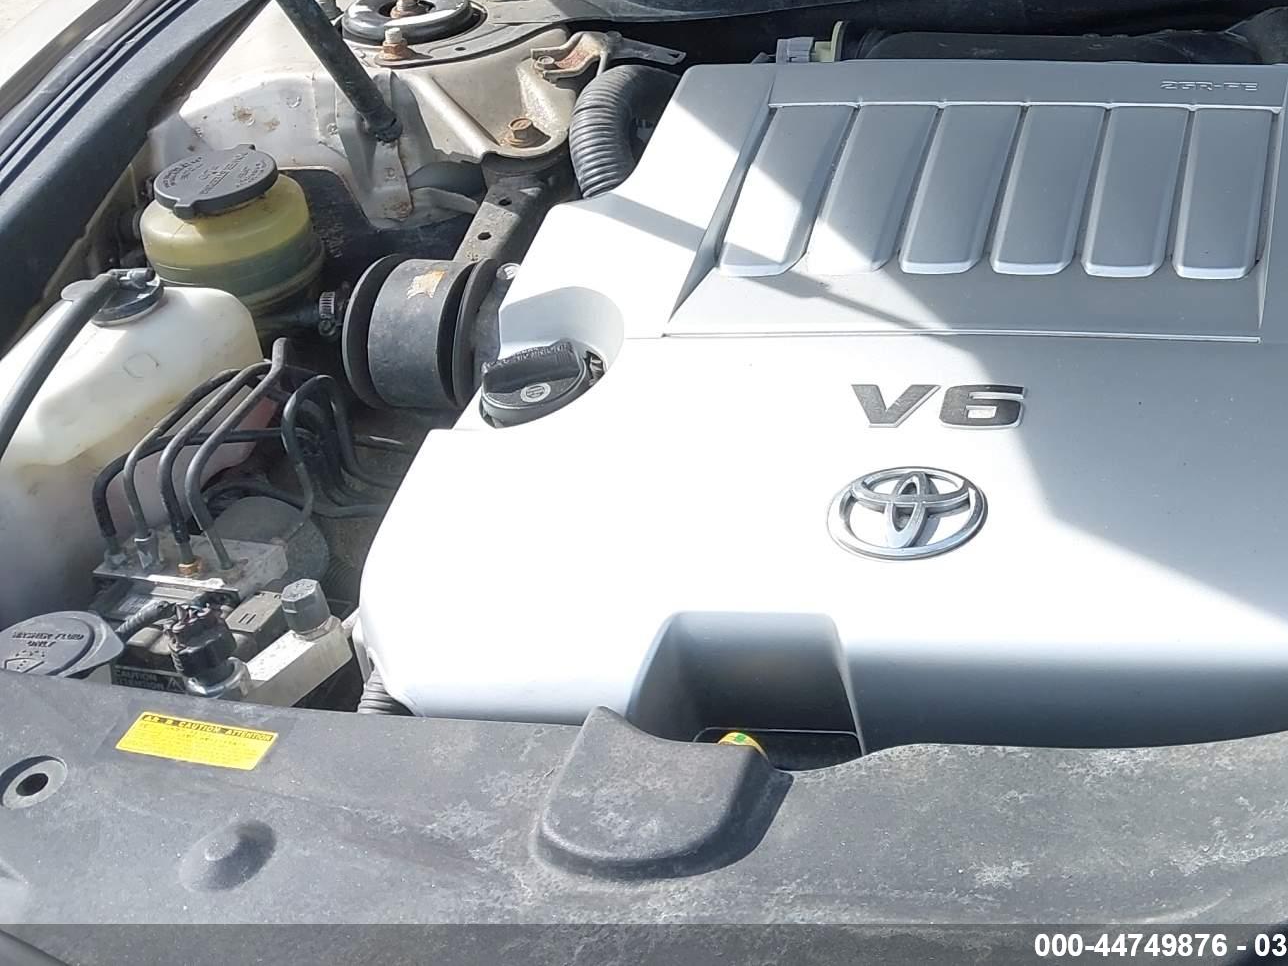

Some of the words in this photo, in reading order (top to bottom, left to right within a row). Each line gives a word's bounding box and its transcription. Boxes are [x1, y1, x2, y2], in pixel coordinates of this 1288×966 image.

[850, 384, 1025, 428] V6
[178, 721, 221, 733] CAUTION
[225, 729, 273, 742] ATTENTION
